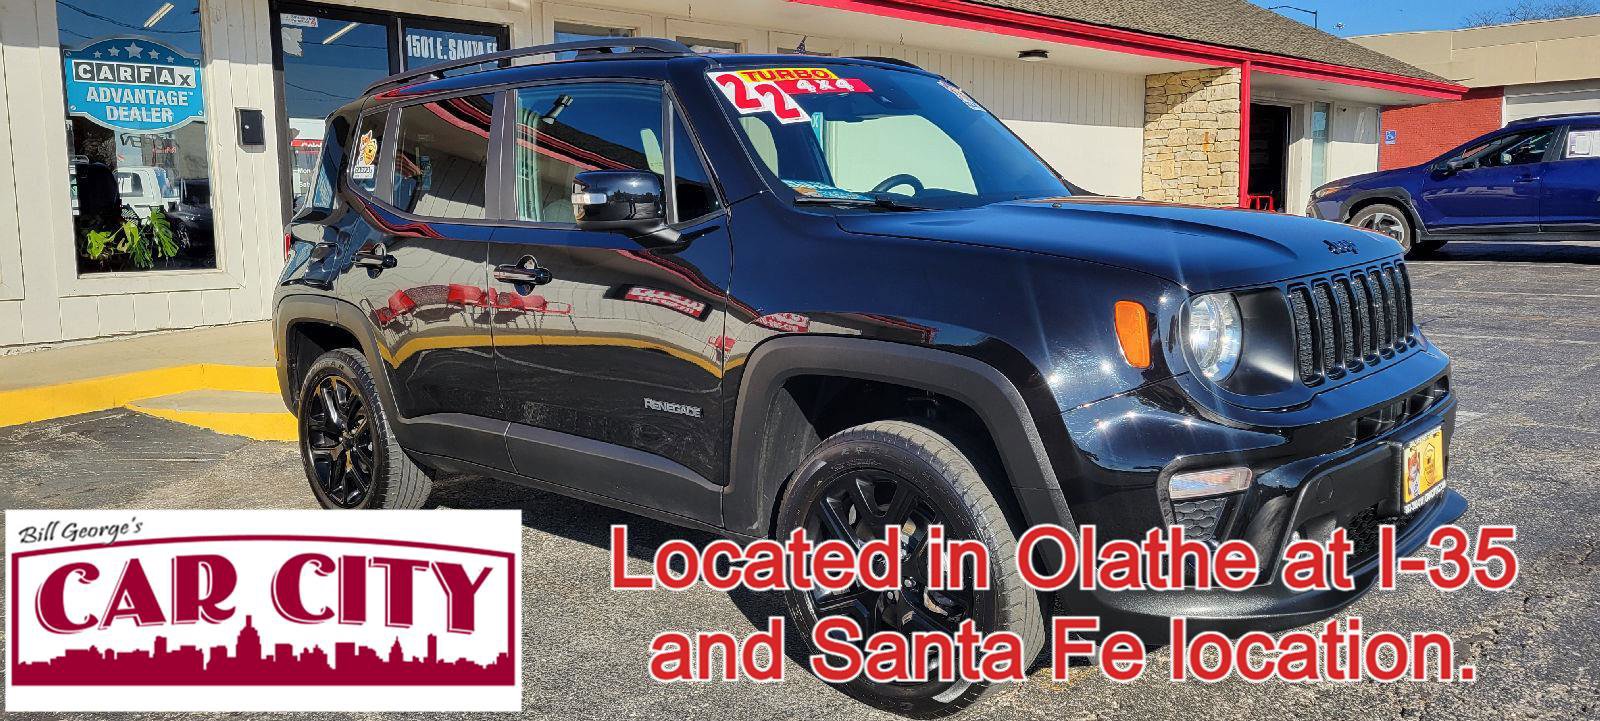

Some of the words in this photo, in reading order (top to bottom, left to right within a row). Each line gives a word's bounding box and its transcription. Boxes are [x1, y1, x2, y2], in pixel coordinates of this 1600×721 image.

[406, 35, 435, 59] 1501
[437, 38, 448, 60] E.
[77, 63, 193, 87] CARFAX
[741, 69, 831, 82] TURBO
[106, 105, 174, 123] DEALER
[643, 397, 702, 419] RENEGADE
